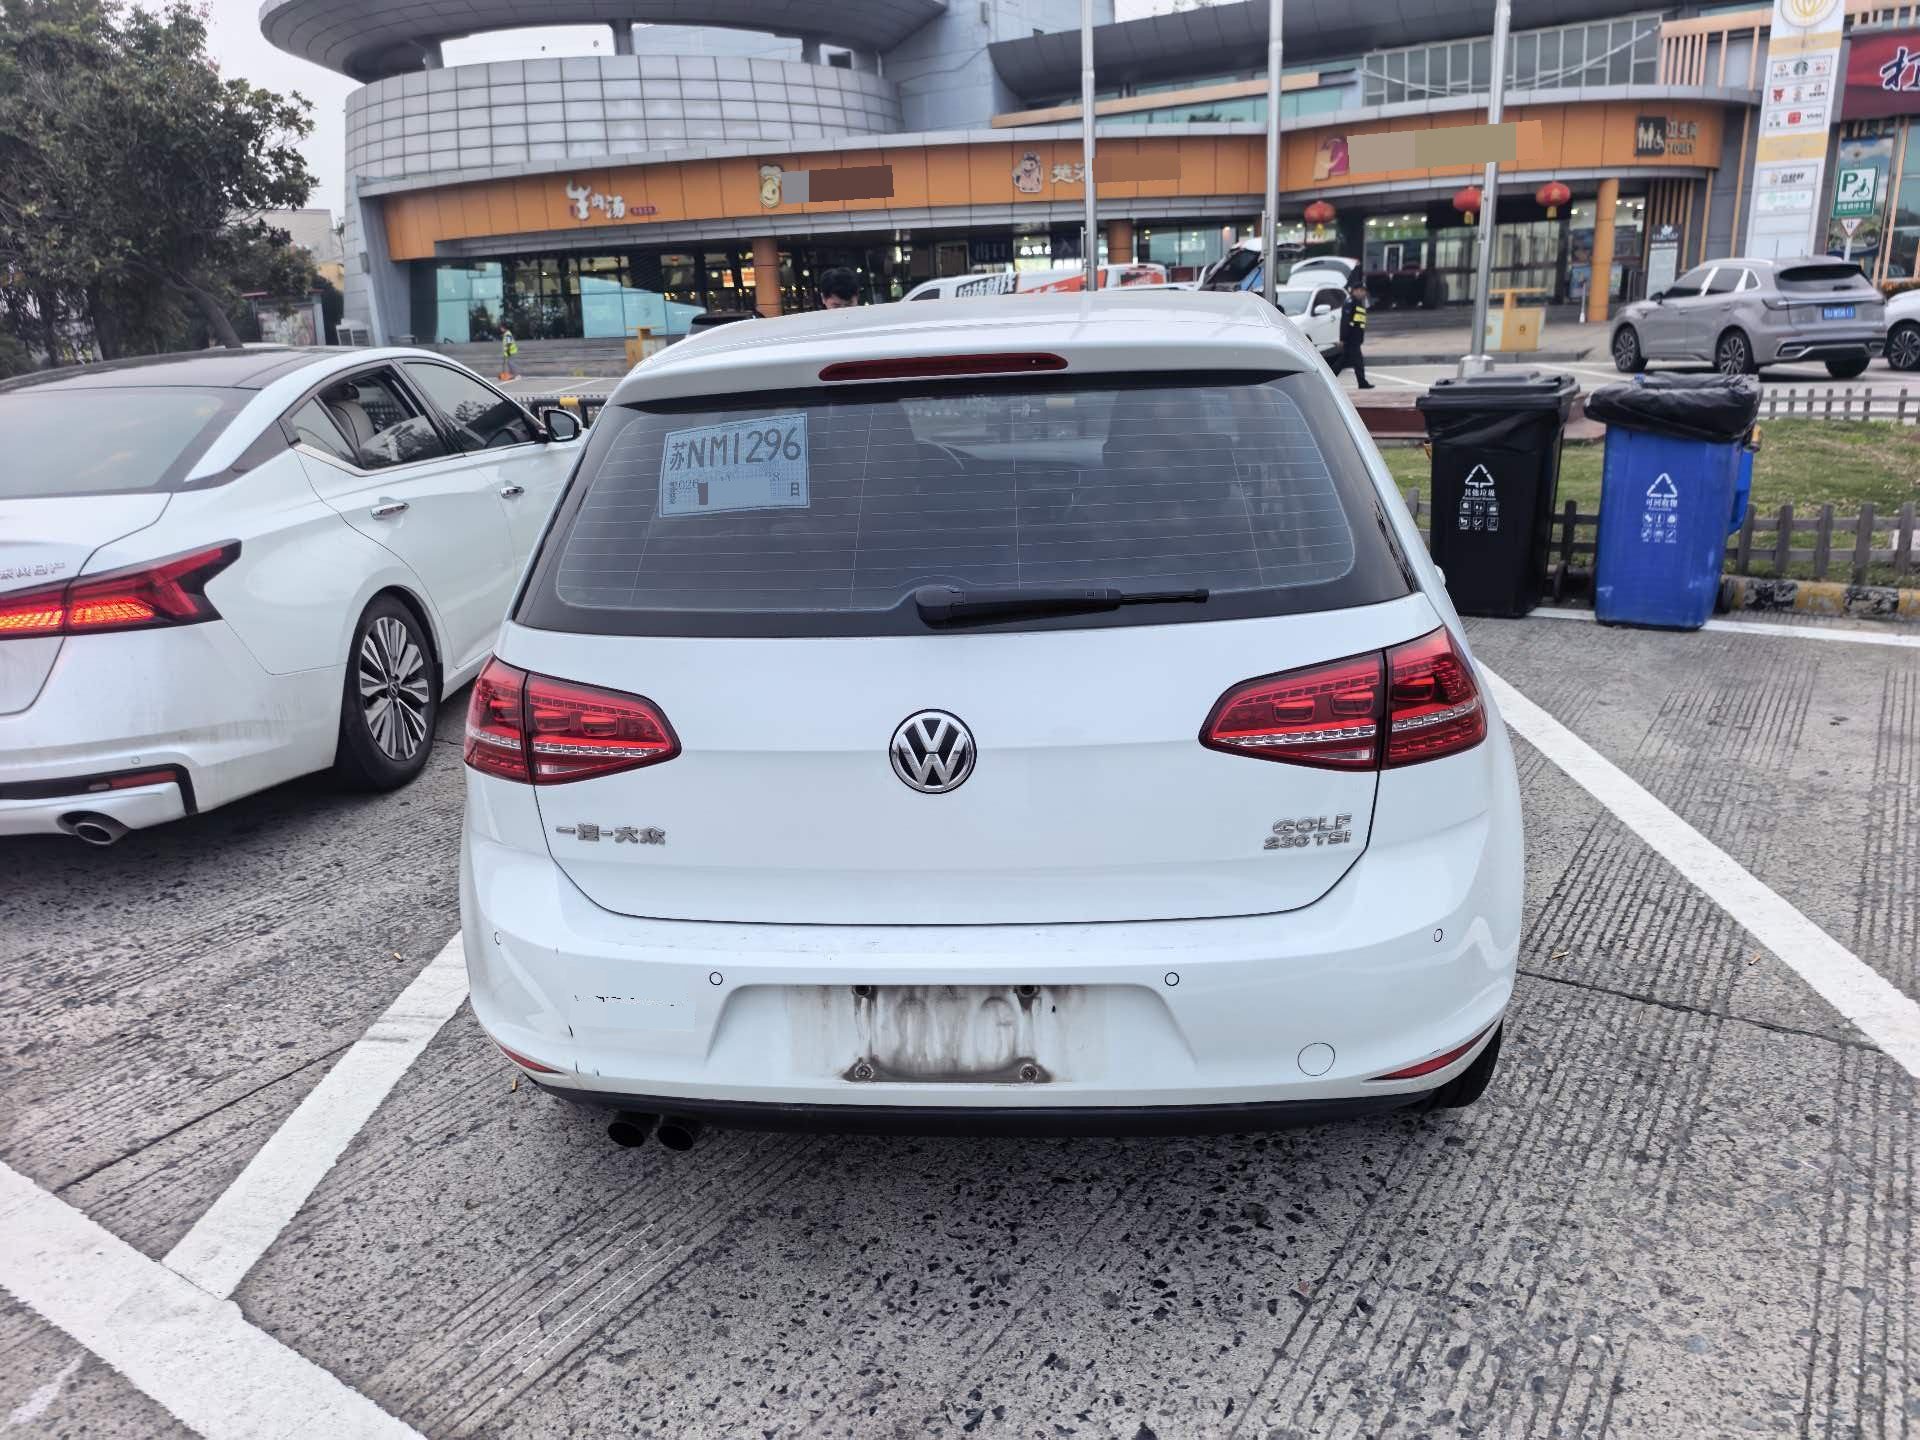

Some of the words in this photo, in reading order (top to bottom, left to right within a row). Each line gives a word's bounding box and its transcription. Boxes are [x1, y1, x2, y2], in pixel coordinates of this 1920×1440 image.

[1842, 173, 1859, 192] P
[670, 427, 802, 471] 苏NM1296
[1464, 488, 1496, 497] 其他垃圾
[1272, 814, 1352, 835] GOLF
